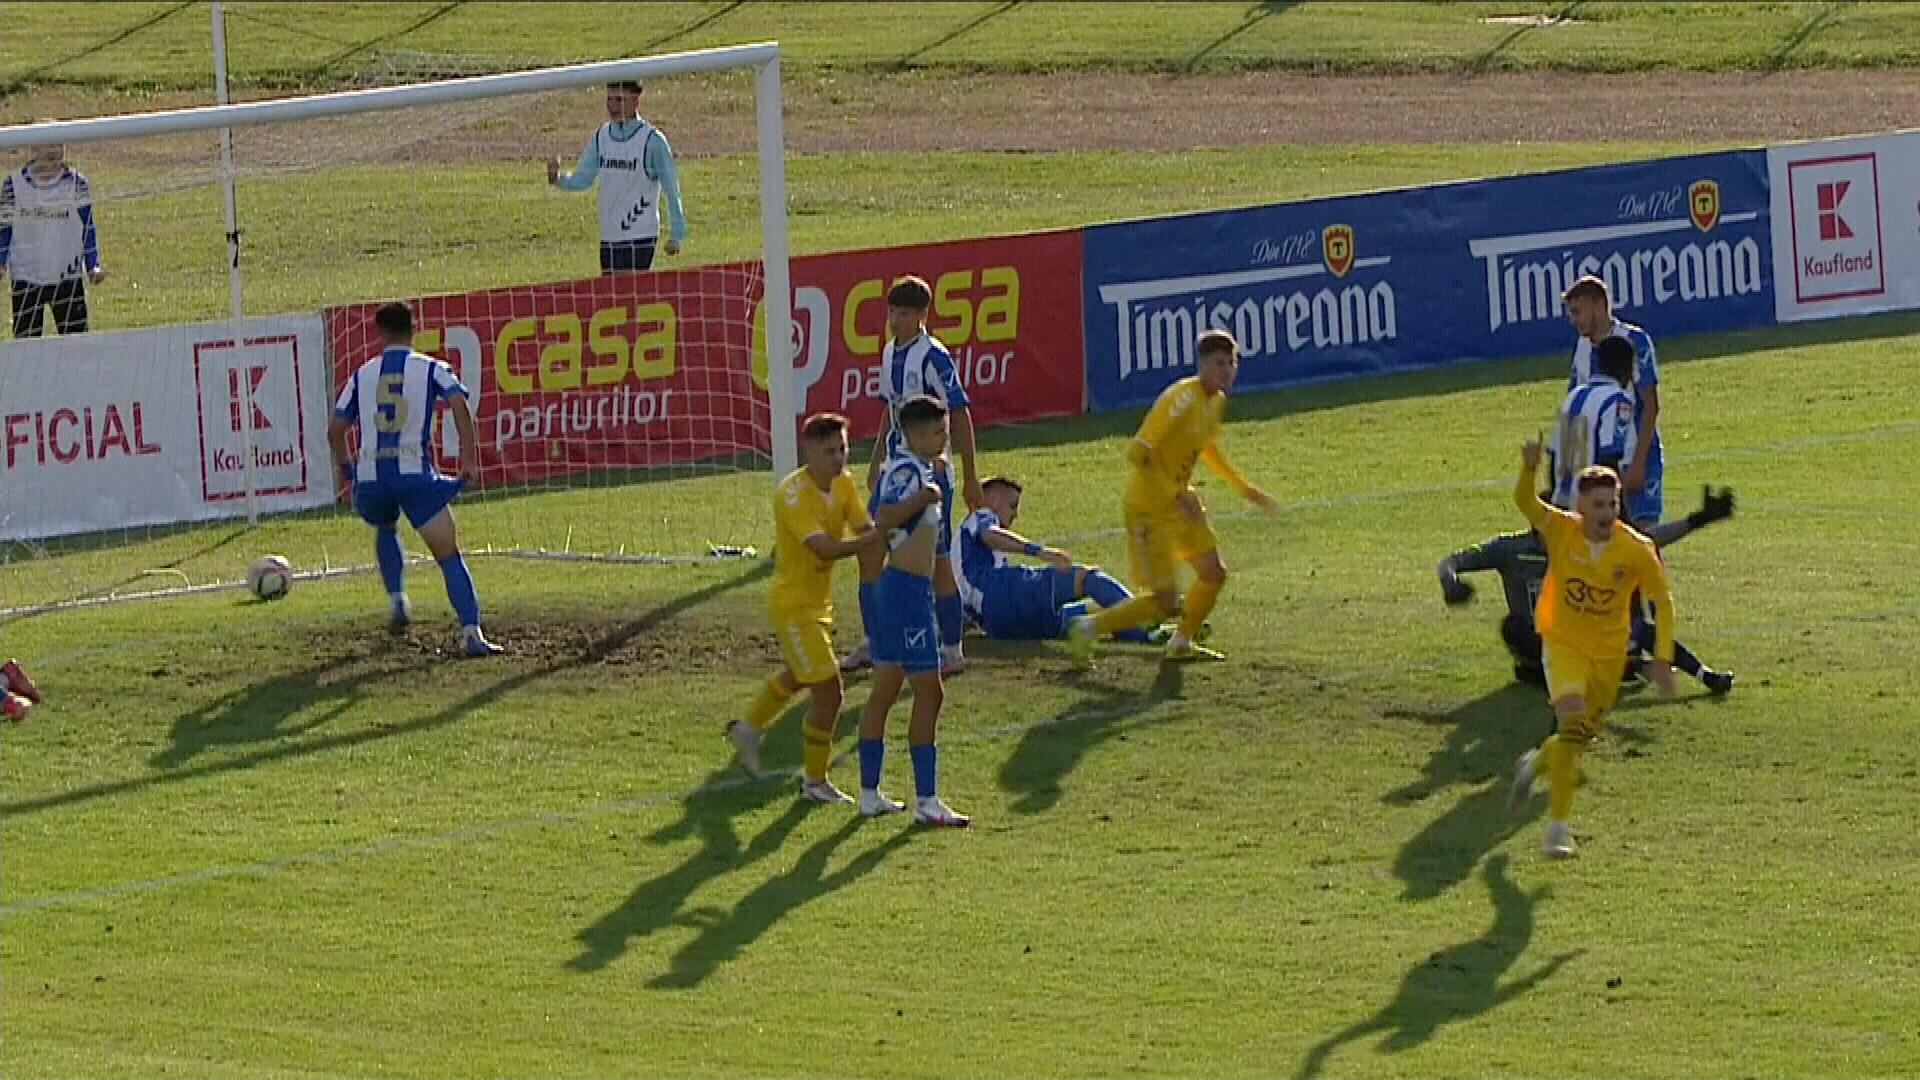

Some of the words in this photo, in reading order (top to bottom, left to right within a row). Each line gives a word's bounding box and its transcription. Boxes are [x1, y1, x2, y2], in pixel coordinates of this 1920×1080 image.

[1648, 184, 1682, 219] 1718
[1281, 229, 1316, 264] 1718
[1803, 249, 1873, 277] Kaufland
[842, 265, 1020, 355] csa
[494, 301, 678, 394] casa
[373, 372, 408, 434] 5
[495, 384, 673, 452] pariurilor
[0, 401, 161, 470] FICIAL
[213, 442, 294, 472] Kauland
